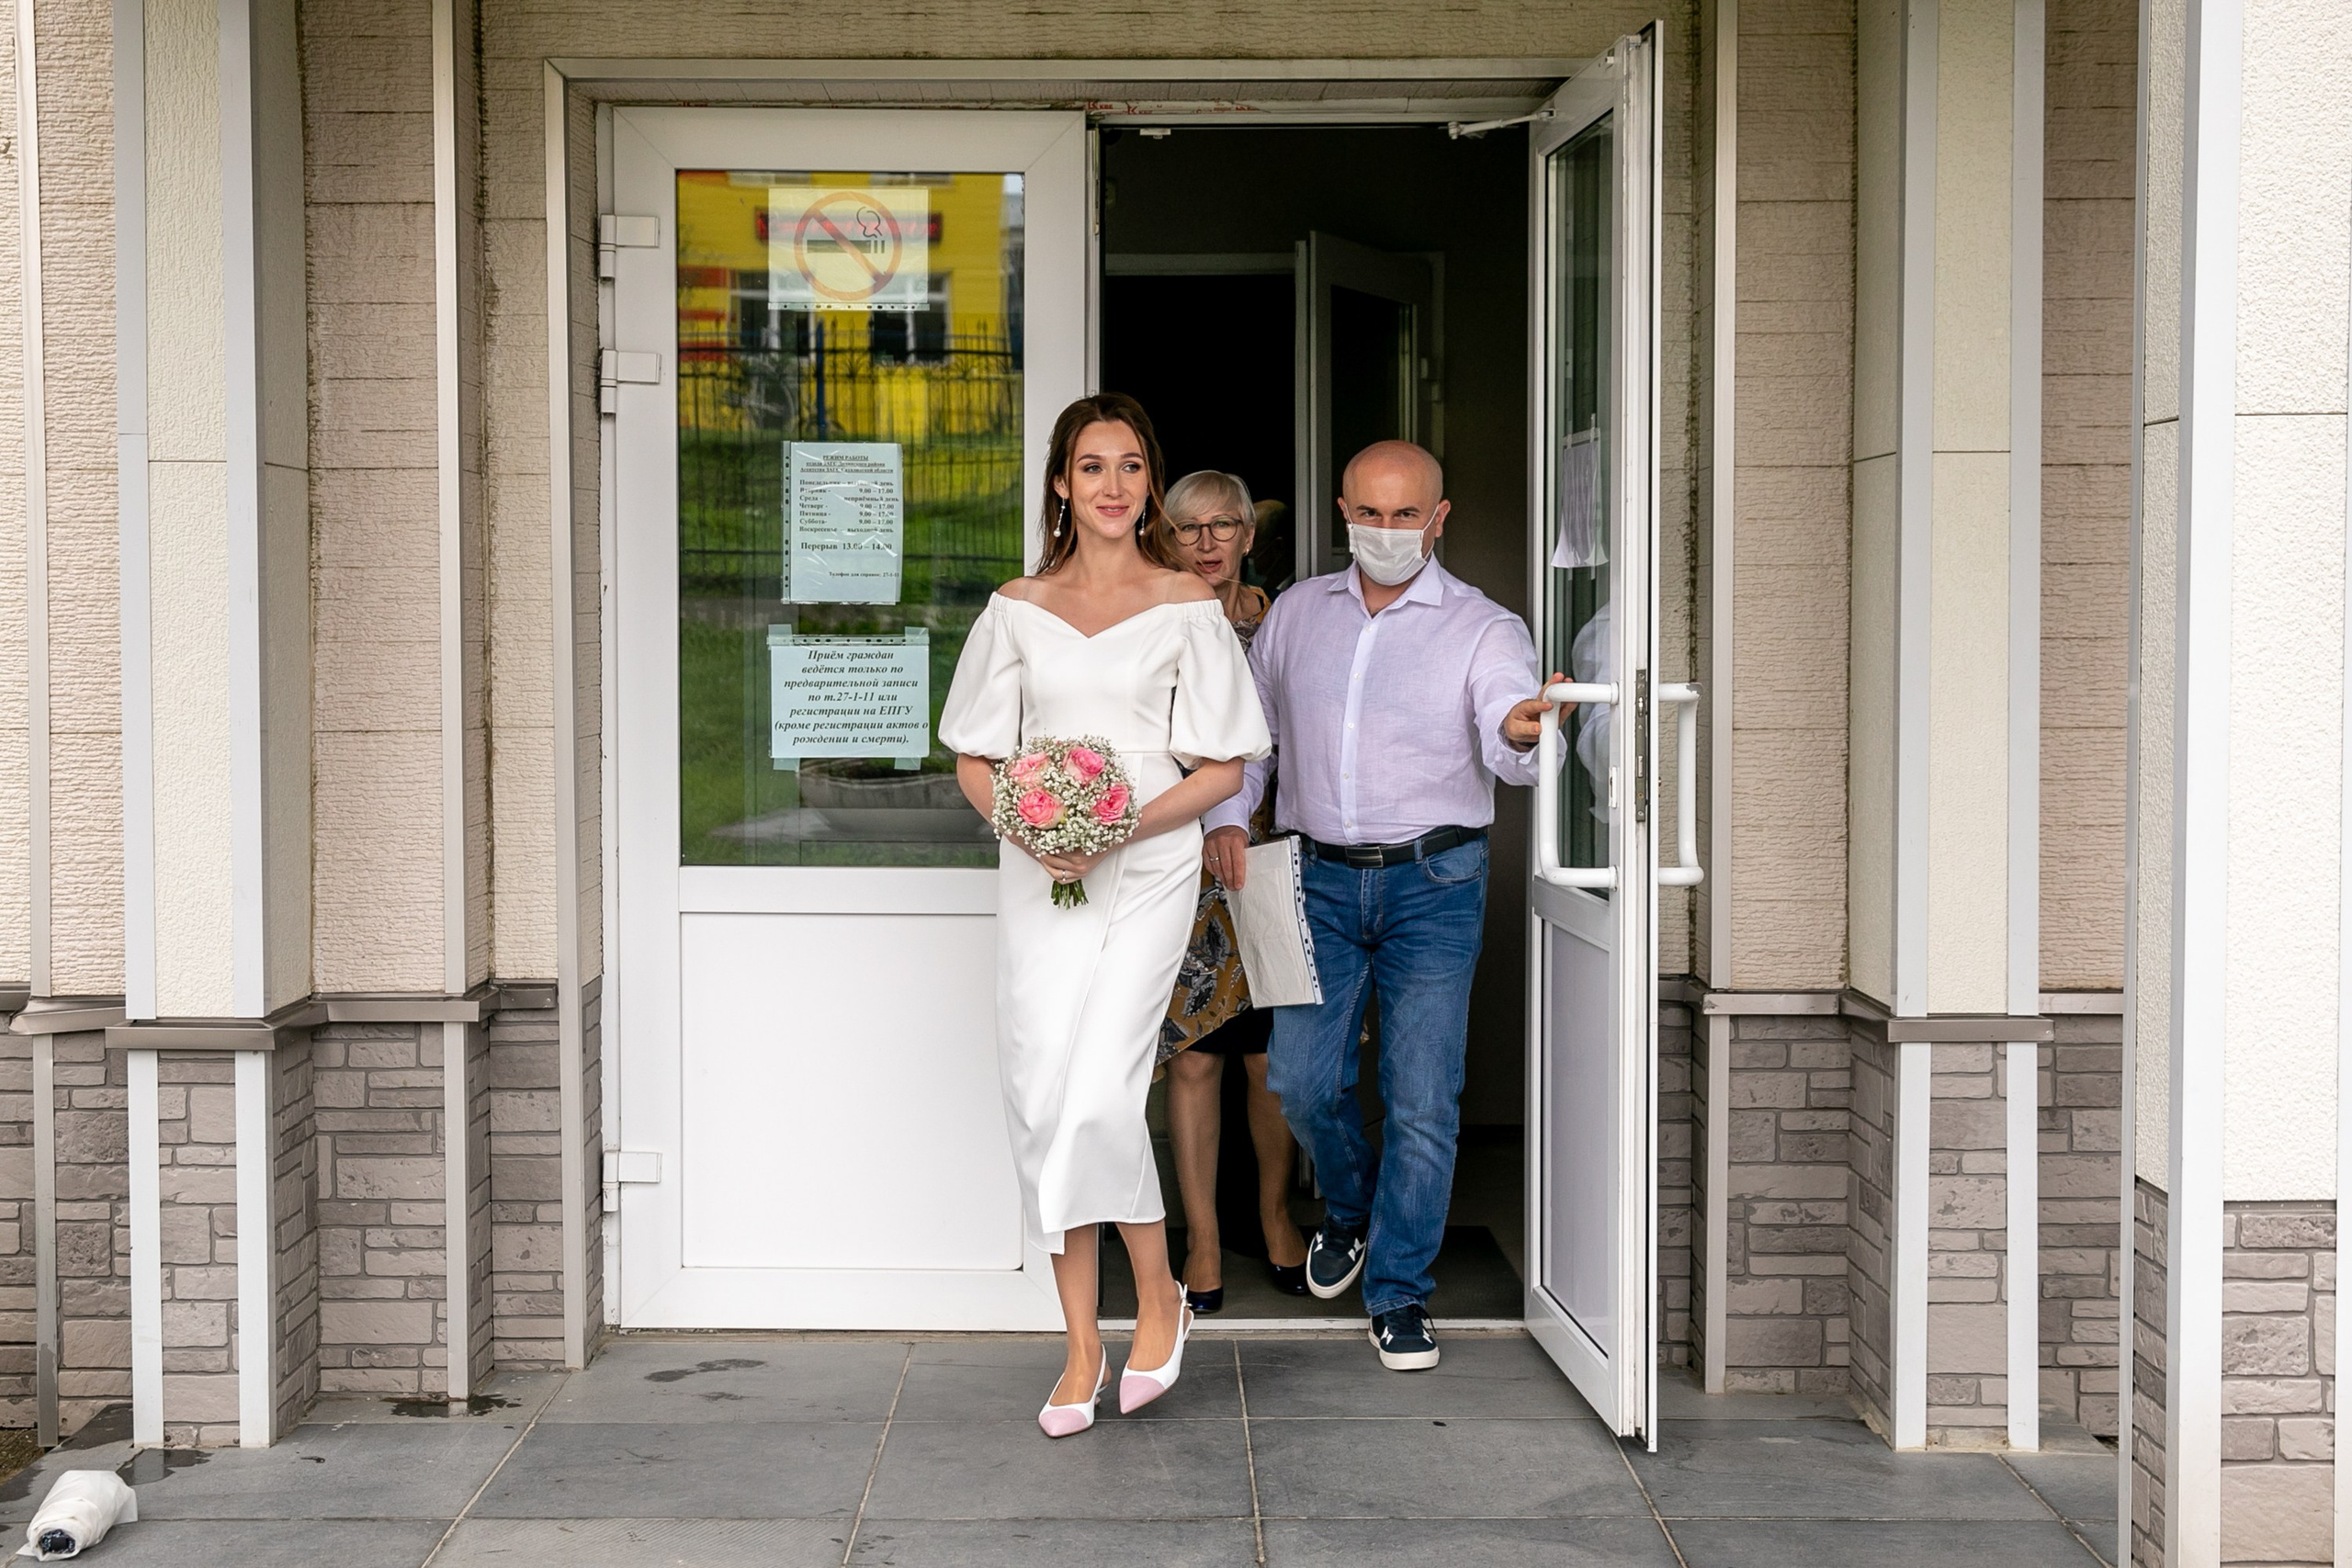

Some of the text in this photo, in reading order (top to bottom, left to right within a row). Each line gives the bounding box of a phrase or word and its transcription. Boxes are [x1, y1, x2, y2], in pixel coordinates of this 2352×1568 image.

[801, 543, 837, 551] Перерыв
[808, 650, 894, 661] Приём граждан
[802, 664, 903, 674] ведётся только по
[784, 679, 878, 689] предварительной
[824, 693, 874, 702] т.27-1-11
[789, 707, 860, 717] регистрации
[879, 705, 912, 716] ЕПГУ
[775, 720, 810, 731] (кроме
[813, 721, 883, 731] регистрации
[793, 735, 849, 745] рождении
[862, 735, 909, 745] смерти).
